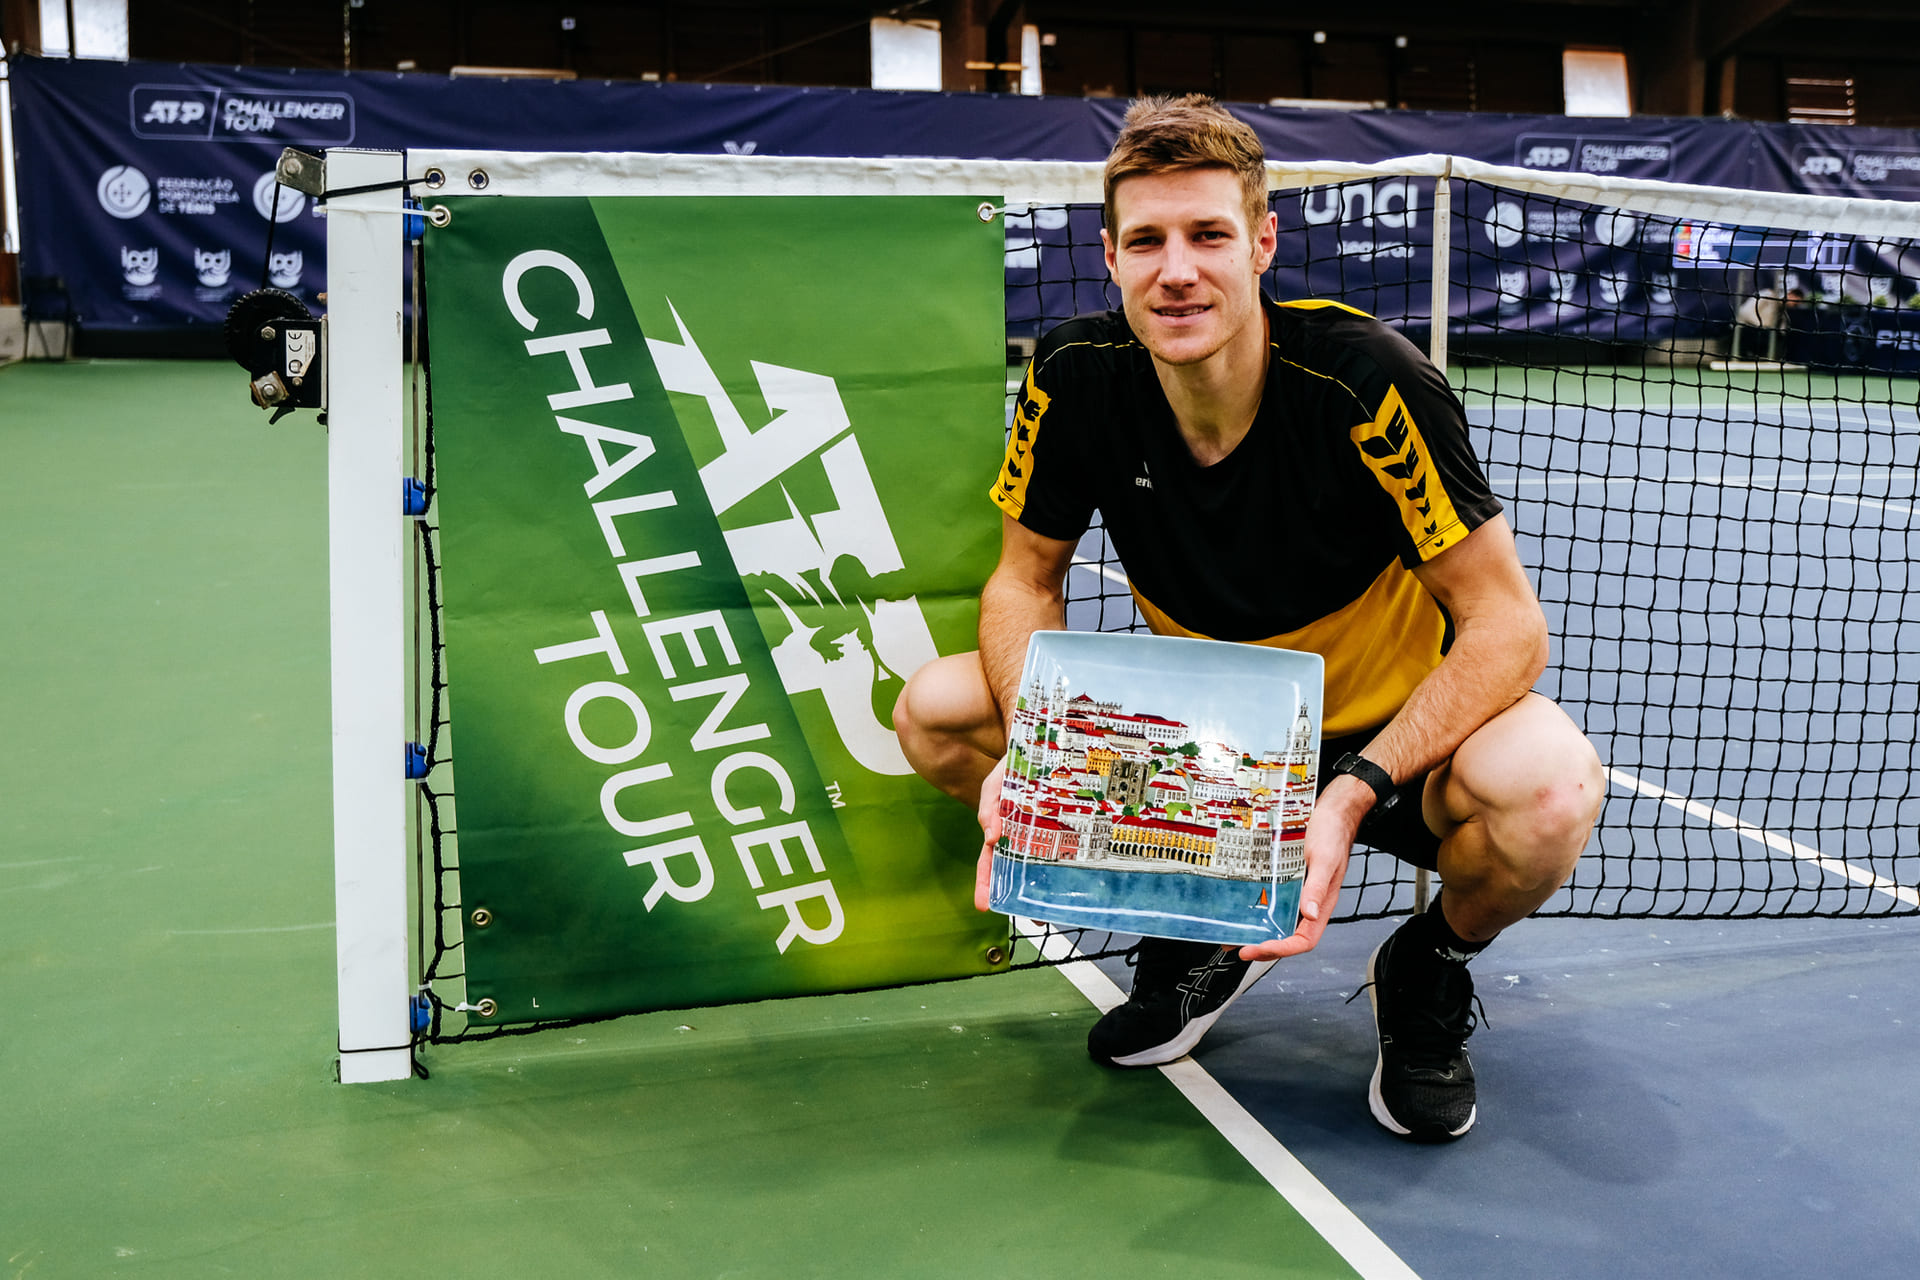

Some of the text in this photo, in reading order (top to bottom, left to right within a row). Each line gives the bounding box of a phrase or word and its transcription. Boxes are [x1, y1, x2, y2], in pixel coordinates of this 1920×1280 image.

[143, 100, 205, 124] ATP
[224, 99, 345, 120] CHALLENGER
[224, 116, 275, 131] TOUR
[1523, 146, 1570, 167] ATP
[1581, 144, 1670, 160] CHALLENGER
[1581, 159, 1619, 172] TOUR
[1300, 182, 1418, 229] una
[645, 296, 940, 776] ATP
[501, 249, 846, 956] CHALLENGER
[534, 610, 716, 913] TOUR
